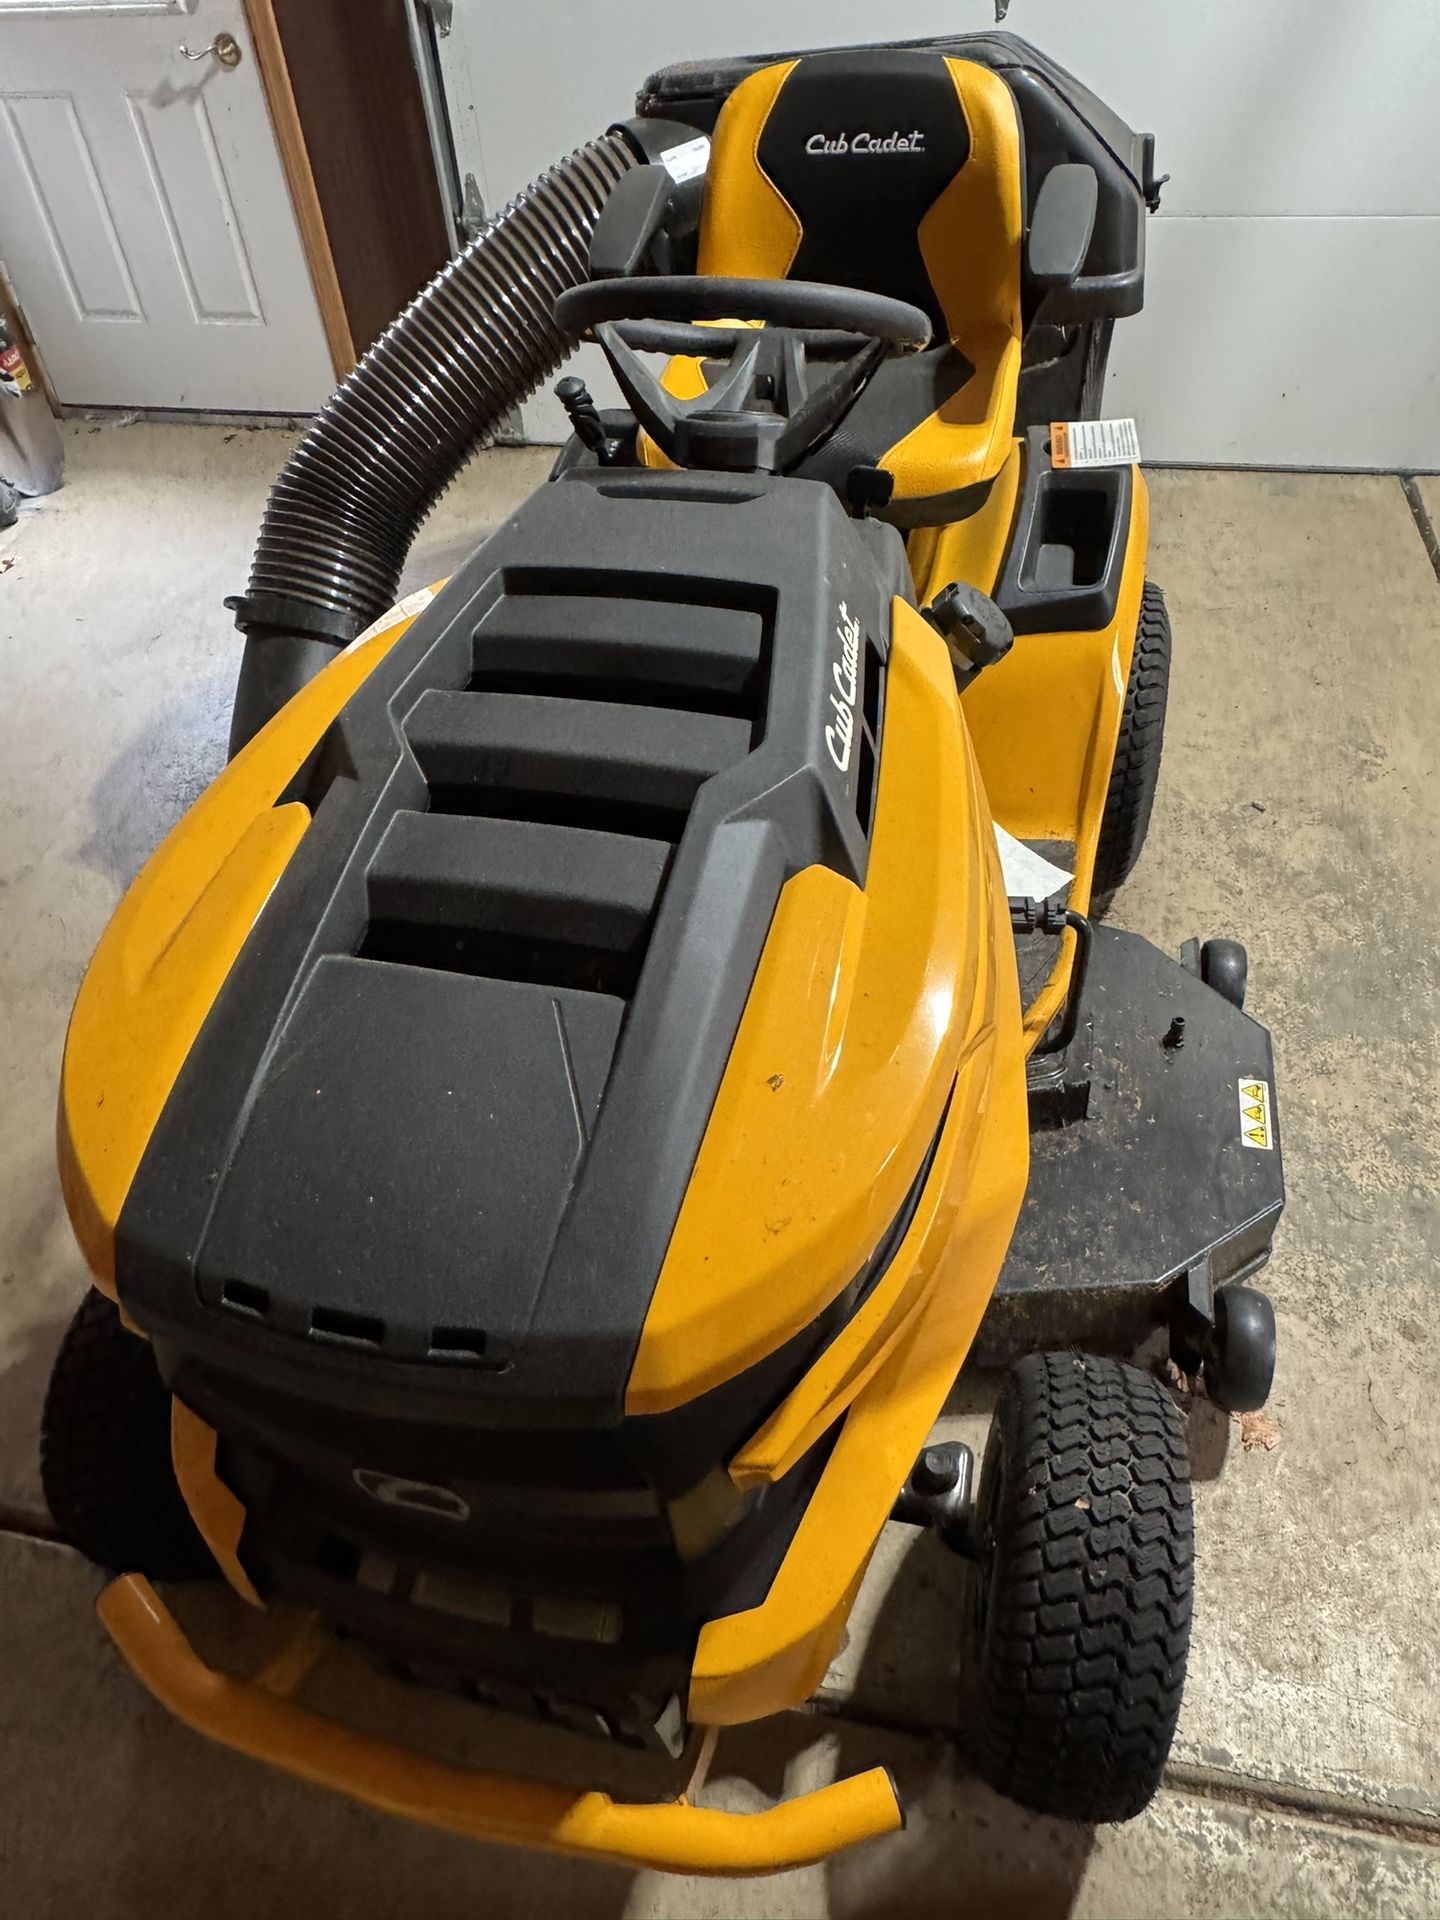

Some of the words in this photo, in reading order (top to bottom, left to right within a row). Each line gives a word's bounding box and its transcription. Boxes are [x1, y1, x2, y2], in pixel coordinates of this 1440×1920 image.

[805, 132, 849, 154] Cub
[851, 130, 922, 153] Cadet
[833, 600, 860, 706] Cadet
[825, 693, 853, 772] Cub
